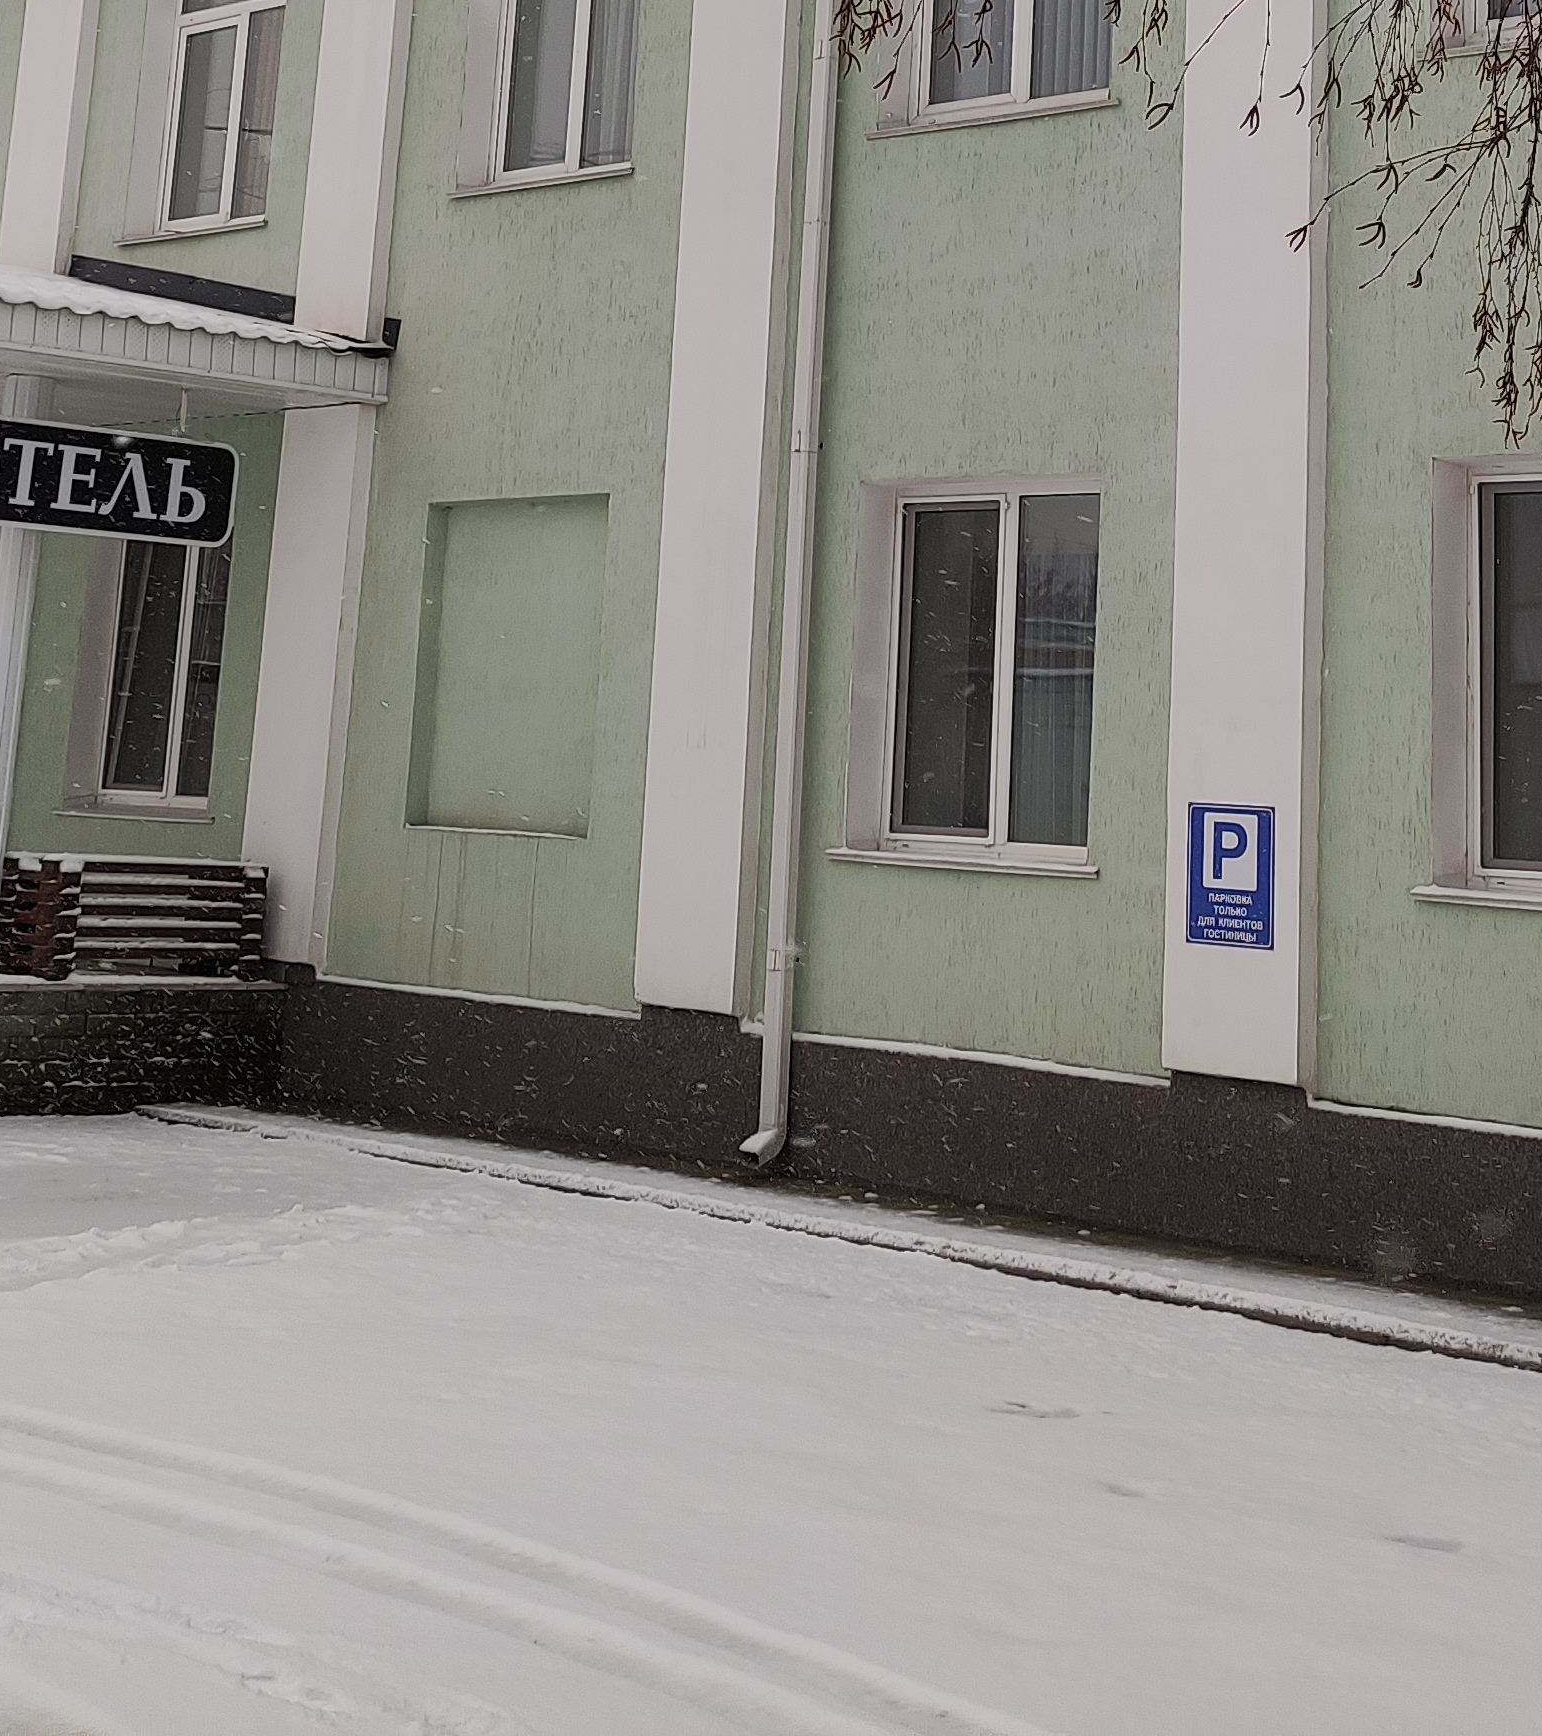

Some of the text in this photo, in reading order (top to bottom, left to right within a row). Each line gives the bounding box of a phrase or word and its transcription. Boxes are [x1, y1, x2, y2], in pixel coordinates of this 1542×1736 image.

[1208, 892, 1253, 906] ПАРКОВКА
[1213, 905, 1248, 917] ТОЛЬКО
[1197, 915, 1263, 931] ДЛЯ КЛИЕНТОВ
[1203, 929, 1257, 942] ГОСТИНИЦЫ
